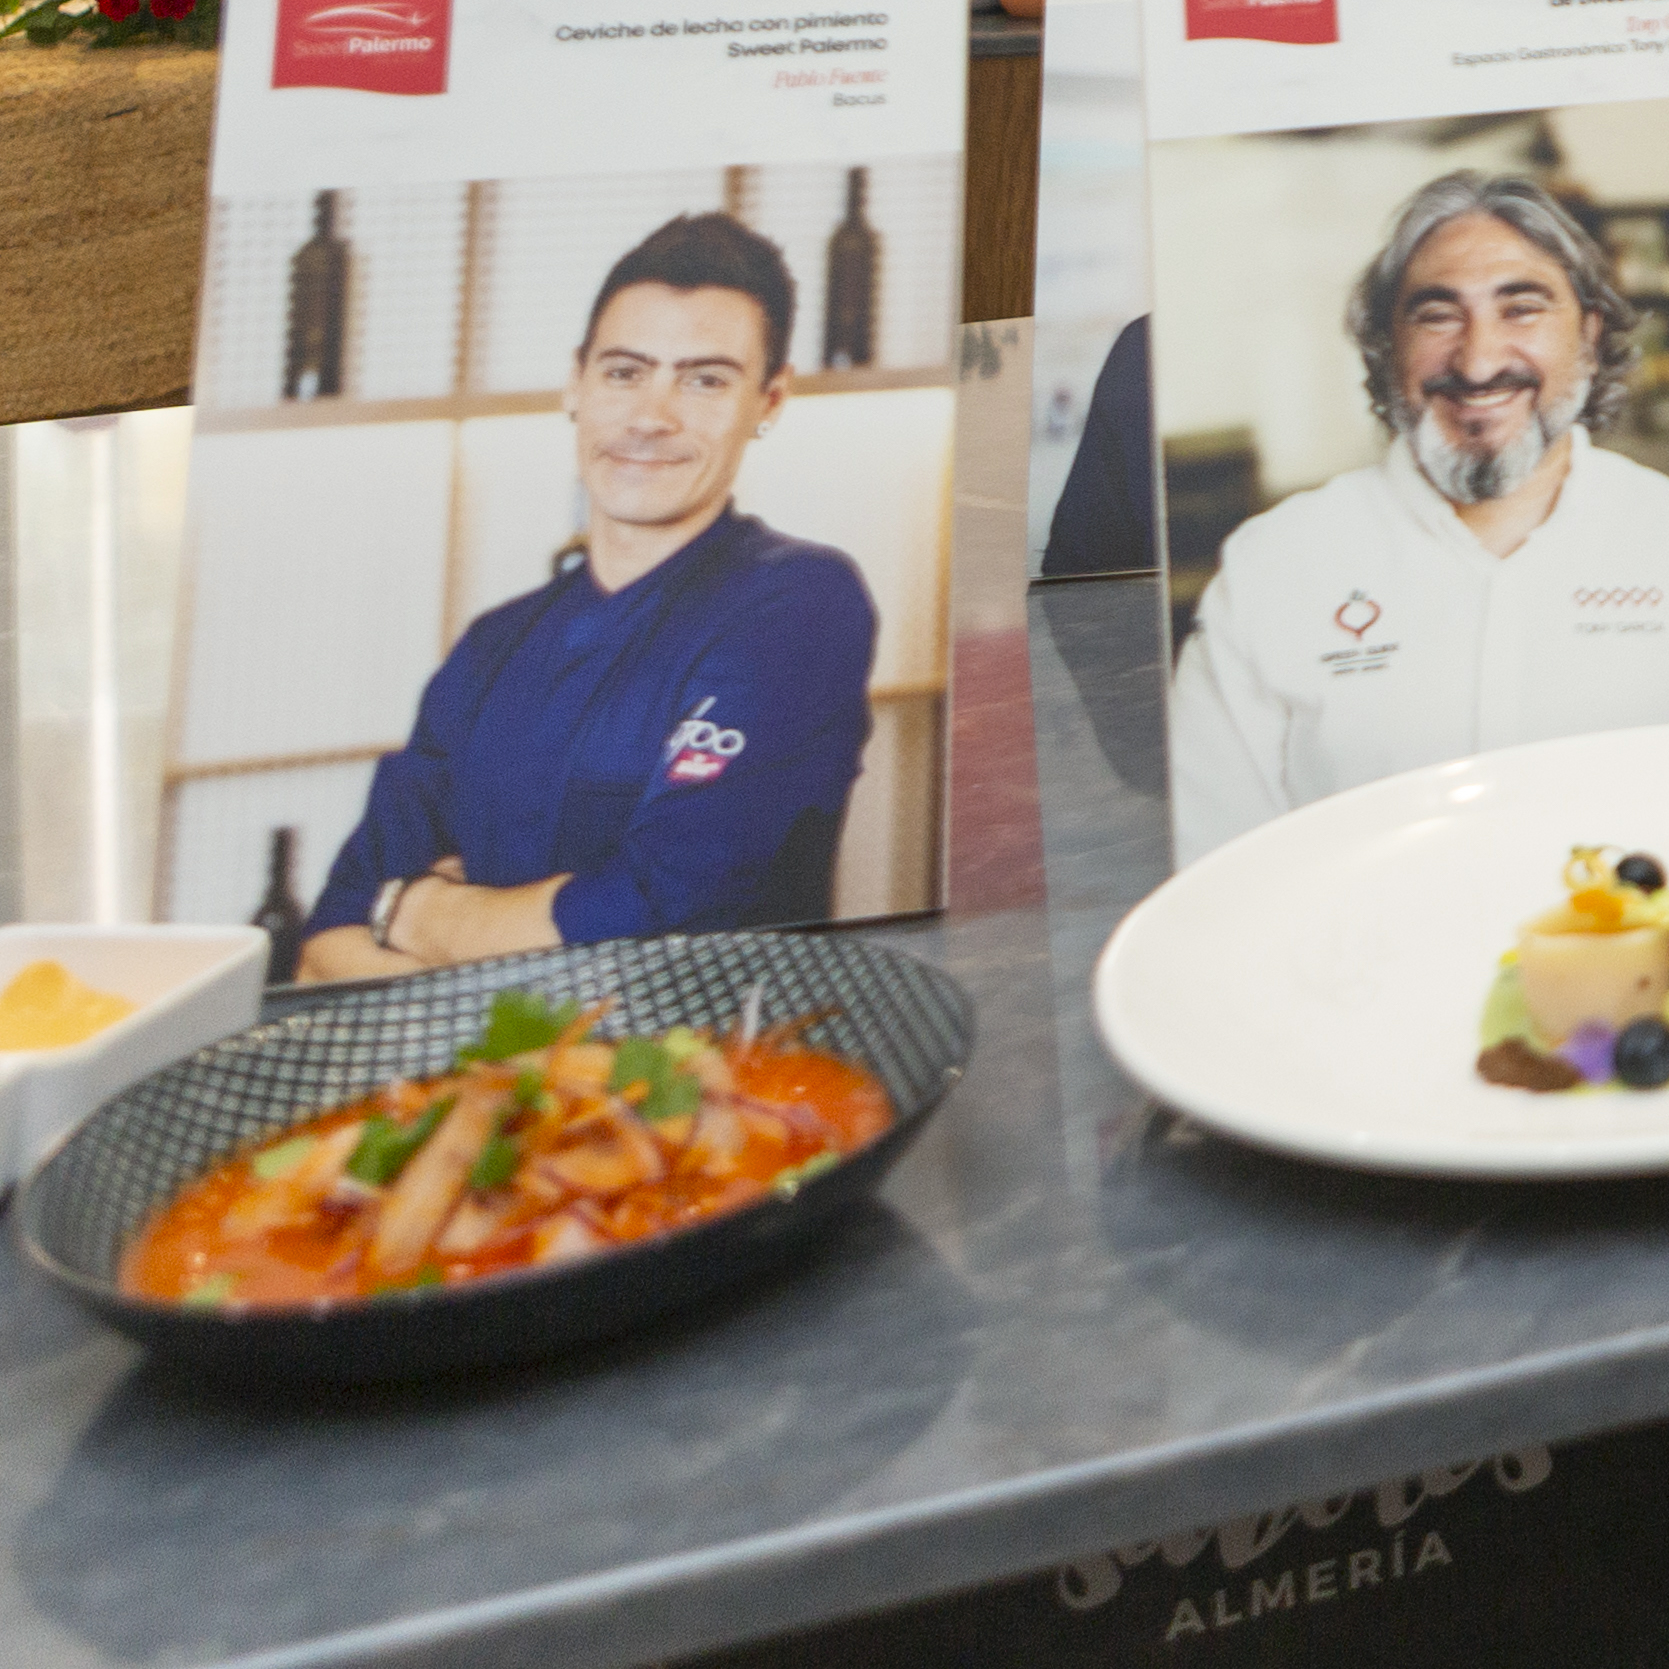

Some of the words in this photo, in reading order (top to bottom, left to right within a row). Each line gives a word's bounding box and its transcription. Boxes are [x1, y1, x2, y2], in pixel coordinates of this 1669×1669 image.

[555, 22, 645, 41] Ceviche
[650, 20, 679, 37] de
[749, 16, 789, 32] con
[794, 12, 889, 32] pimiento
[727, 41, 796, 58] Sweet
[798, 37, 888, 54] Palermo
[833, 92, 887, 106] Bacus
[1164, 1530, 1453, 1642] ALMERÍA
